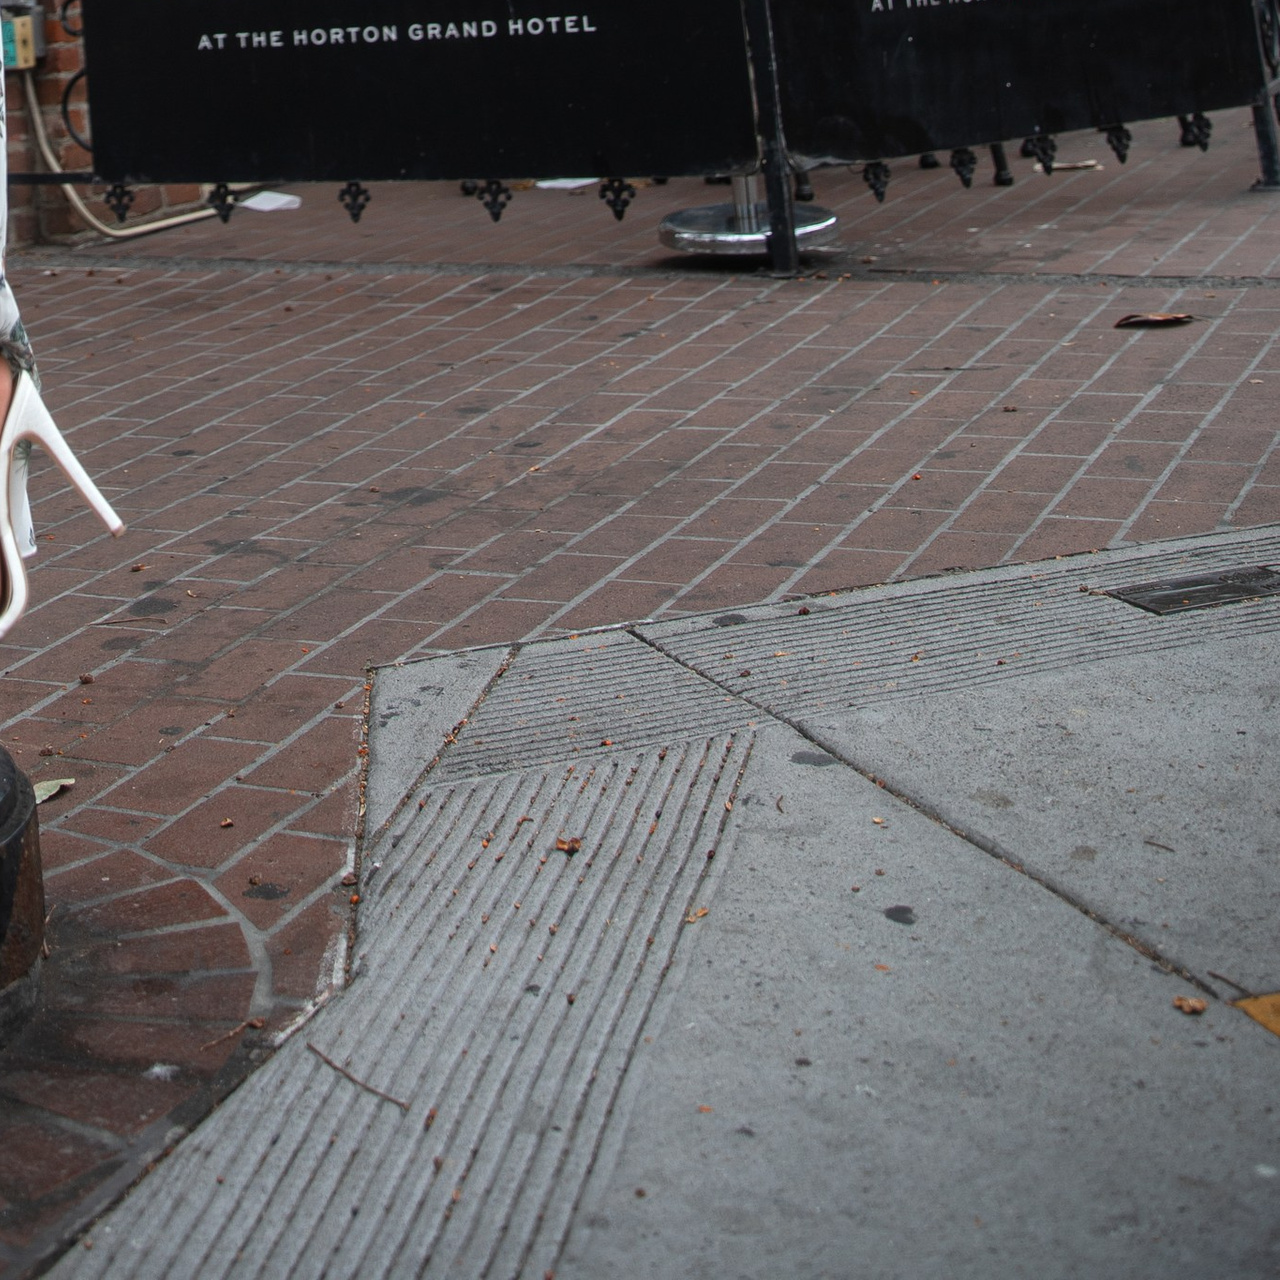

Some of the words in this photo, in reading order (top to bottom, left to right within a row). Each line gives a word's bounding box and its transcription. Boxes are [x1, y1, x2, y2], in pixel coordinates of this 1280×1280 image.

[197, 33, 228, 51] AT
[237, 30, 284, 49] THE
[293, 25, 398, 45] HORTON
[408, 19, 497, 42] GRAND
[508, 15, 597, 37] HOTEL
